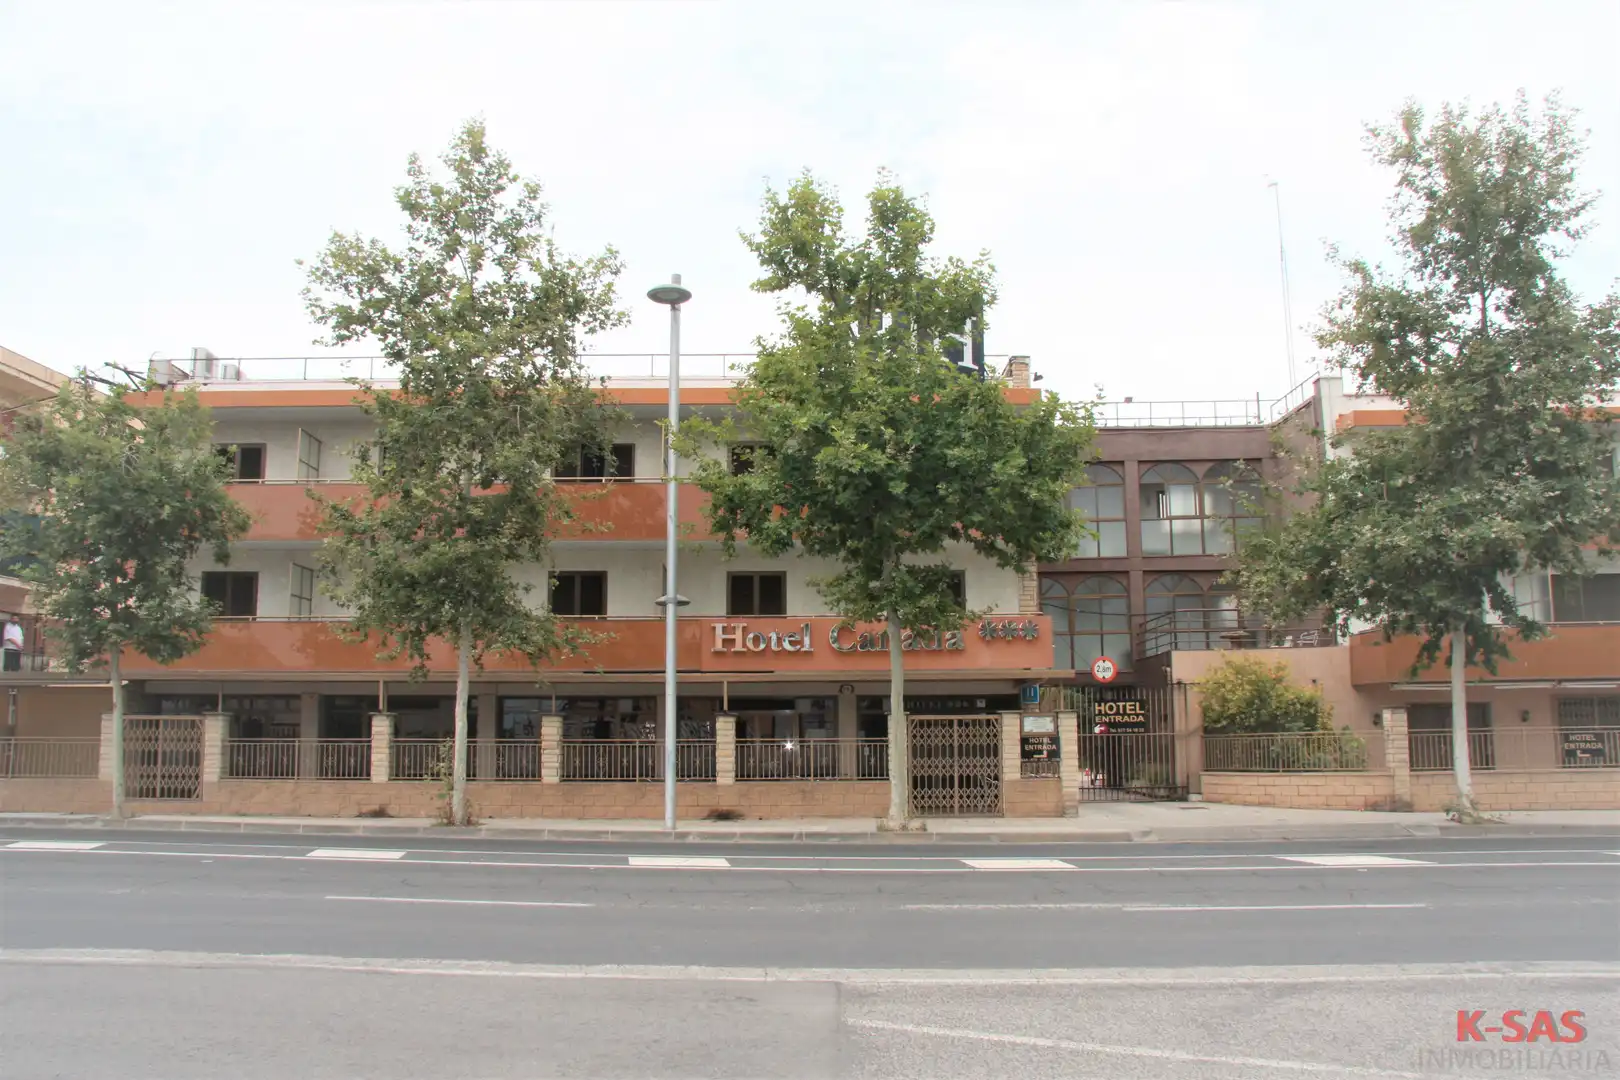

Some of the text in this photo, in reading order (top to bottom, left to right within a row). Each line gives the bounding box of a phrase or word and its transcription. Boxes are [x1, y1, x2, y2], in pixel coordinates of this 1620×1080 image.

[711, 621, 814, 652] Hotel
[1094, 702, 1145, 715] HOTEL
[1095, 715, 1145, 723] ENTRADA
